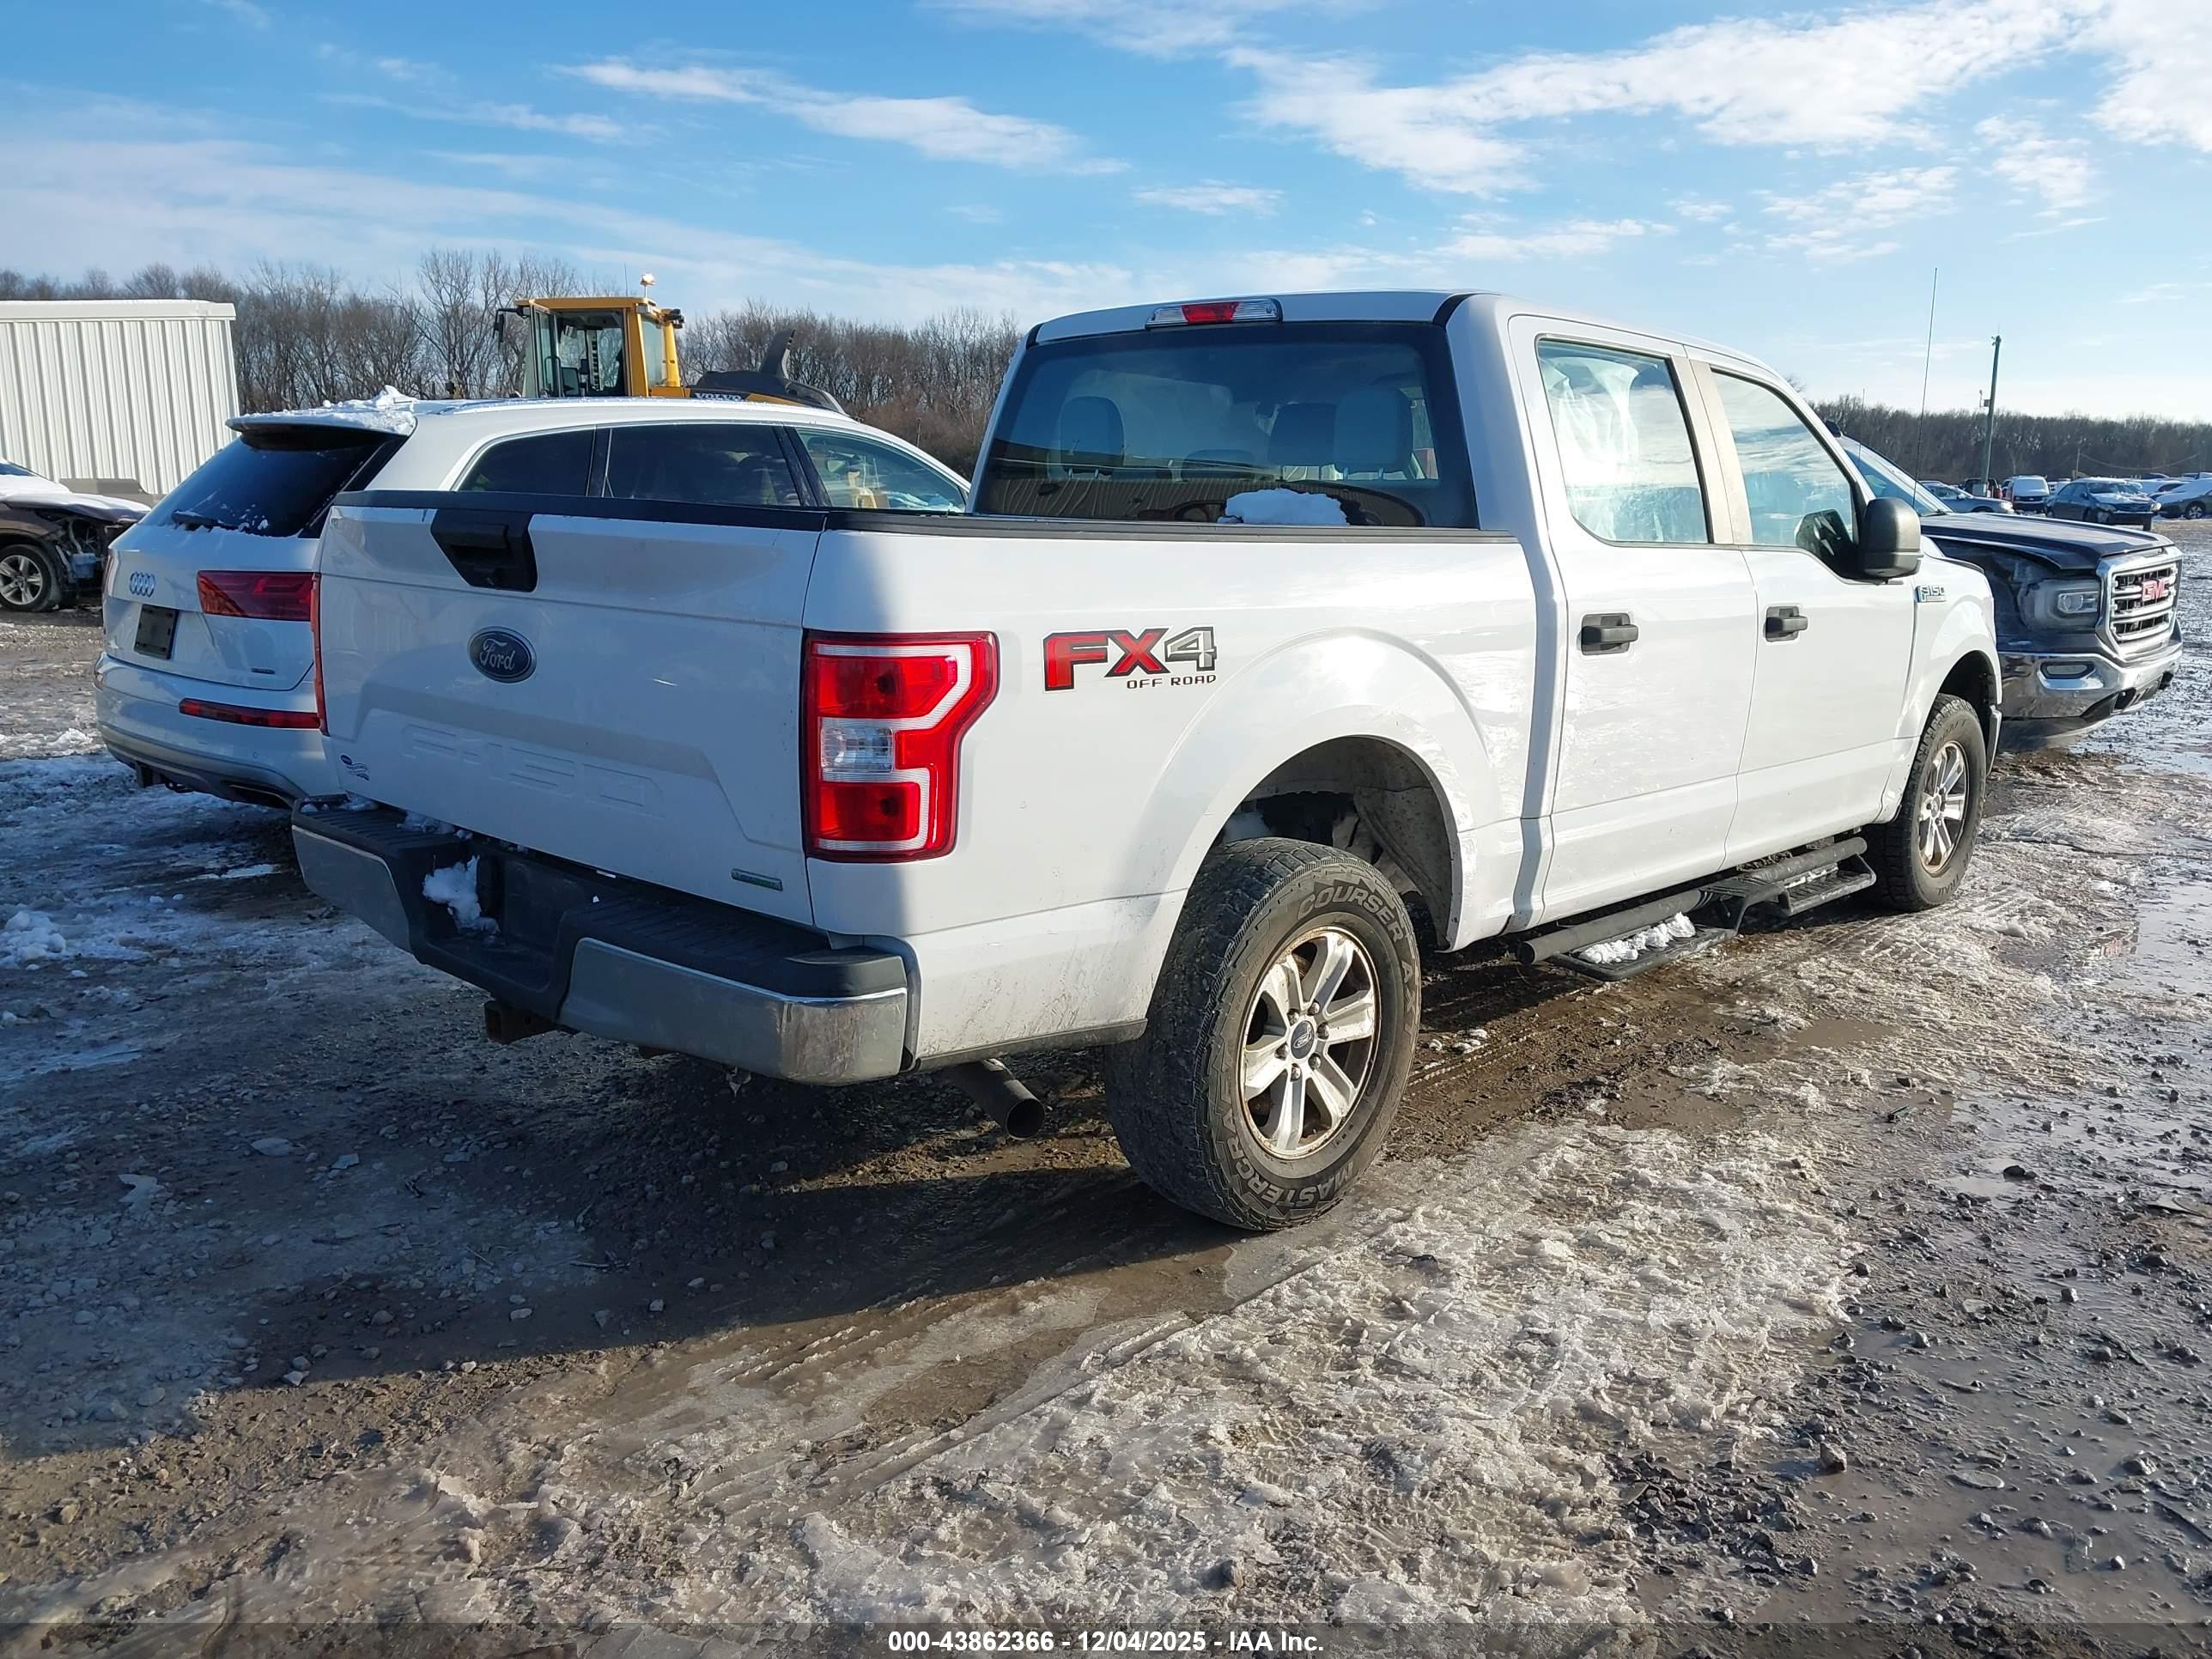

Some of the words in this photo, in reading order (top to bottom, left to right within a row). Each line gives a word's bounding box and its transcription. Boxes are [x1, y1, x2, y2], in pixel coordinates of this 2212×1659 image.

[694, 392, 743, 402] VOLVO
[2142, 576, 2174, 601] GMC
[480, 638, 515, 670] Ford
[1043, 627, 1218, 691] FX4
[1127, 679, 1163, 690] OFF
[1170, 674, 1217, 686] ROAD
[1297, 885, 1405, 944] COURSER
